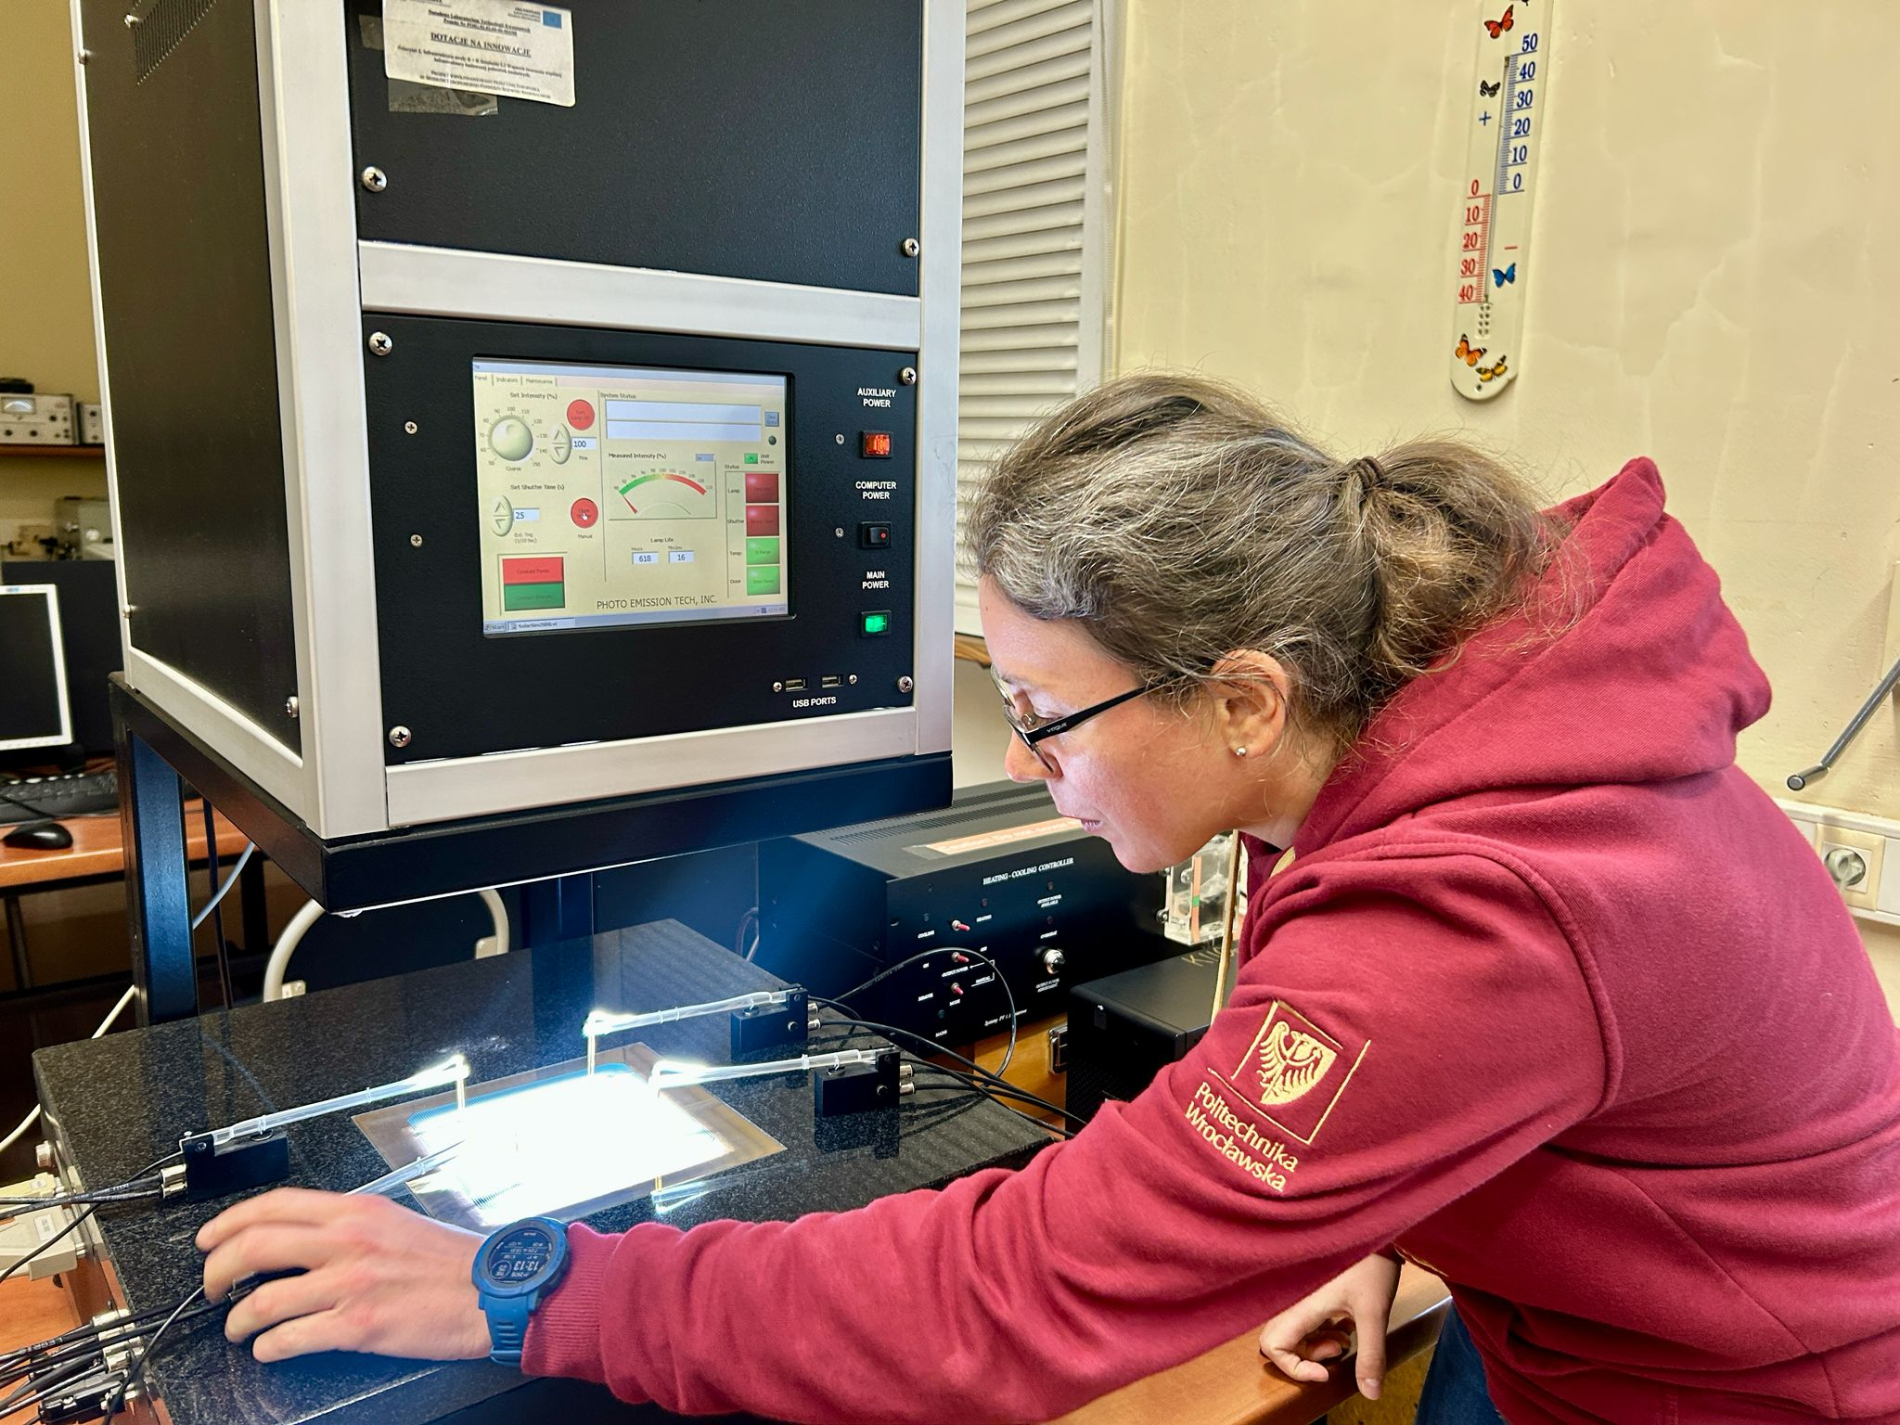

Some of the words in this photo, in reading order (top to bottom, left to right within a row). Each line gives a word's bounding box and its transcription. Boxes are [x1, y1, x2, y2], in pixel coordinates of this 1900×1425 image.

[431, 32, 468, 48] DOTACJE
[470, 39, 483, 50] NA
[484, 41, 531, 58] INNOWACJE
[1522, 33, 1538, 52] 50
[1519, 61, 1536, 80] 40
[1516, 89, 1533, 108] 30
[1514, 117, 1531, 136] 20
[1511, 145, 1527, 163] 10
[1471, 179, 1479, 196] 0
[1513, 172, 1522, 190] 0
[1465, 206, 1479, 223] 10
[1463, 232, 1478, 249] 20
[1461, 258, 1476, 276] 30
[1459, 284, 1474, 301] 40
[521, 392, 545, 400] Intensity
[857, 387, 897, 398] AUXILIARY
[863, 398, 891, 408] POWER
[573, 440, 587, 448] 100
[855, 480, 897, 491] COMPUTER
[862, 490, 890, 500] POWER
[515, 511, 525, 519] 25
[638, 555, 652, 563] 618
[866, 571, 885, 580] MAIN
[862, 579, 889, 590] POWER
[596, 599, 627, 610] PHOTO
[630, 597, 672, 608] EMISSION
[674, 596, 698, 607] TECH,
[700, 594, 718, 604] INC.
[792, 698, 810, 708] USB
[810, 696, 837, 707] PORTS
[1038, 857, 1074, 872] CONTROLLER
[1194, 1082, 1299, 1173] Politechnika
[1184, 1101, 1287, 1193] Wrocławska
